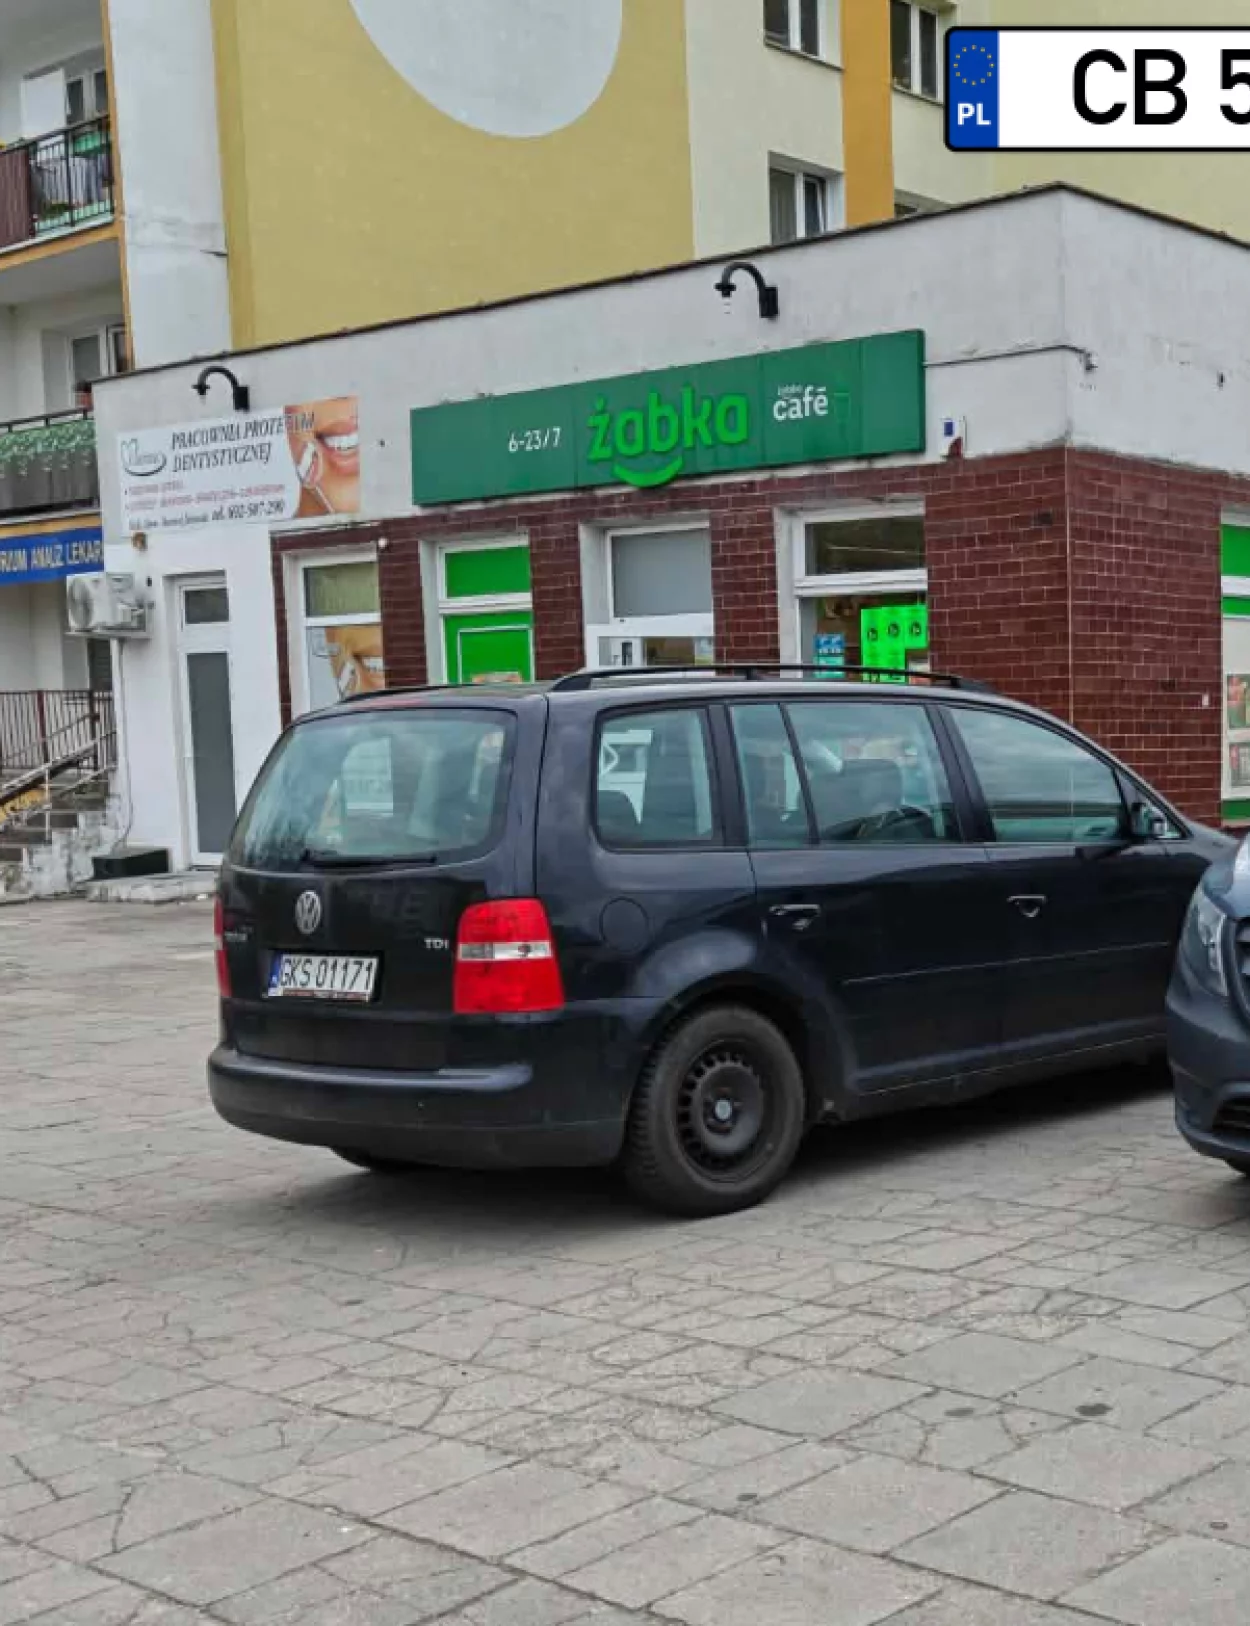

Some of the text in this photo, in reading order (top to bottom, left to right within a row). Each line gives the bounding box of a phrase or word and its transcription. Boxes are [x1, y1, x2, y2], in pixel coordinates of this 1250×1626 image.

[773, 385, 829, 422] café
[586, 384, 749, 463] żabka
[424, 938, 450, 949] TDI
[280, 957, 374, 990] GKS 01171
